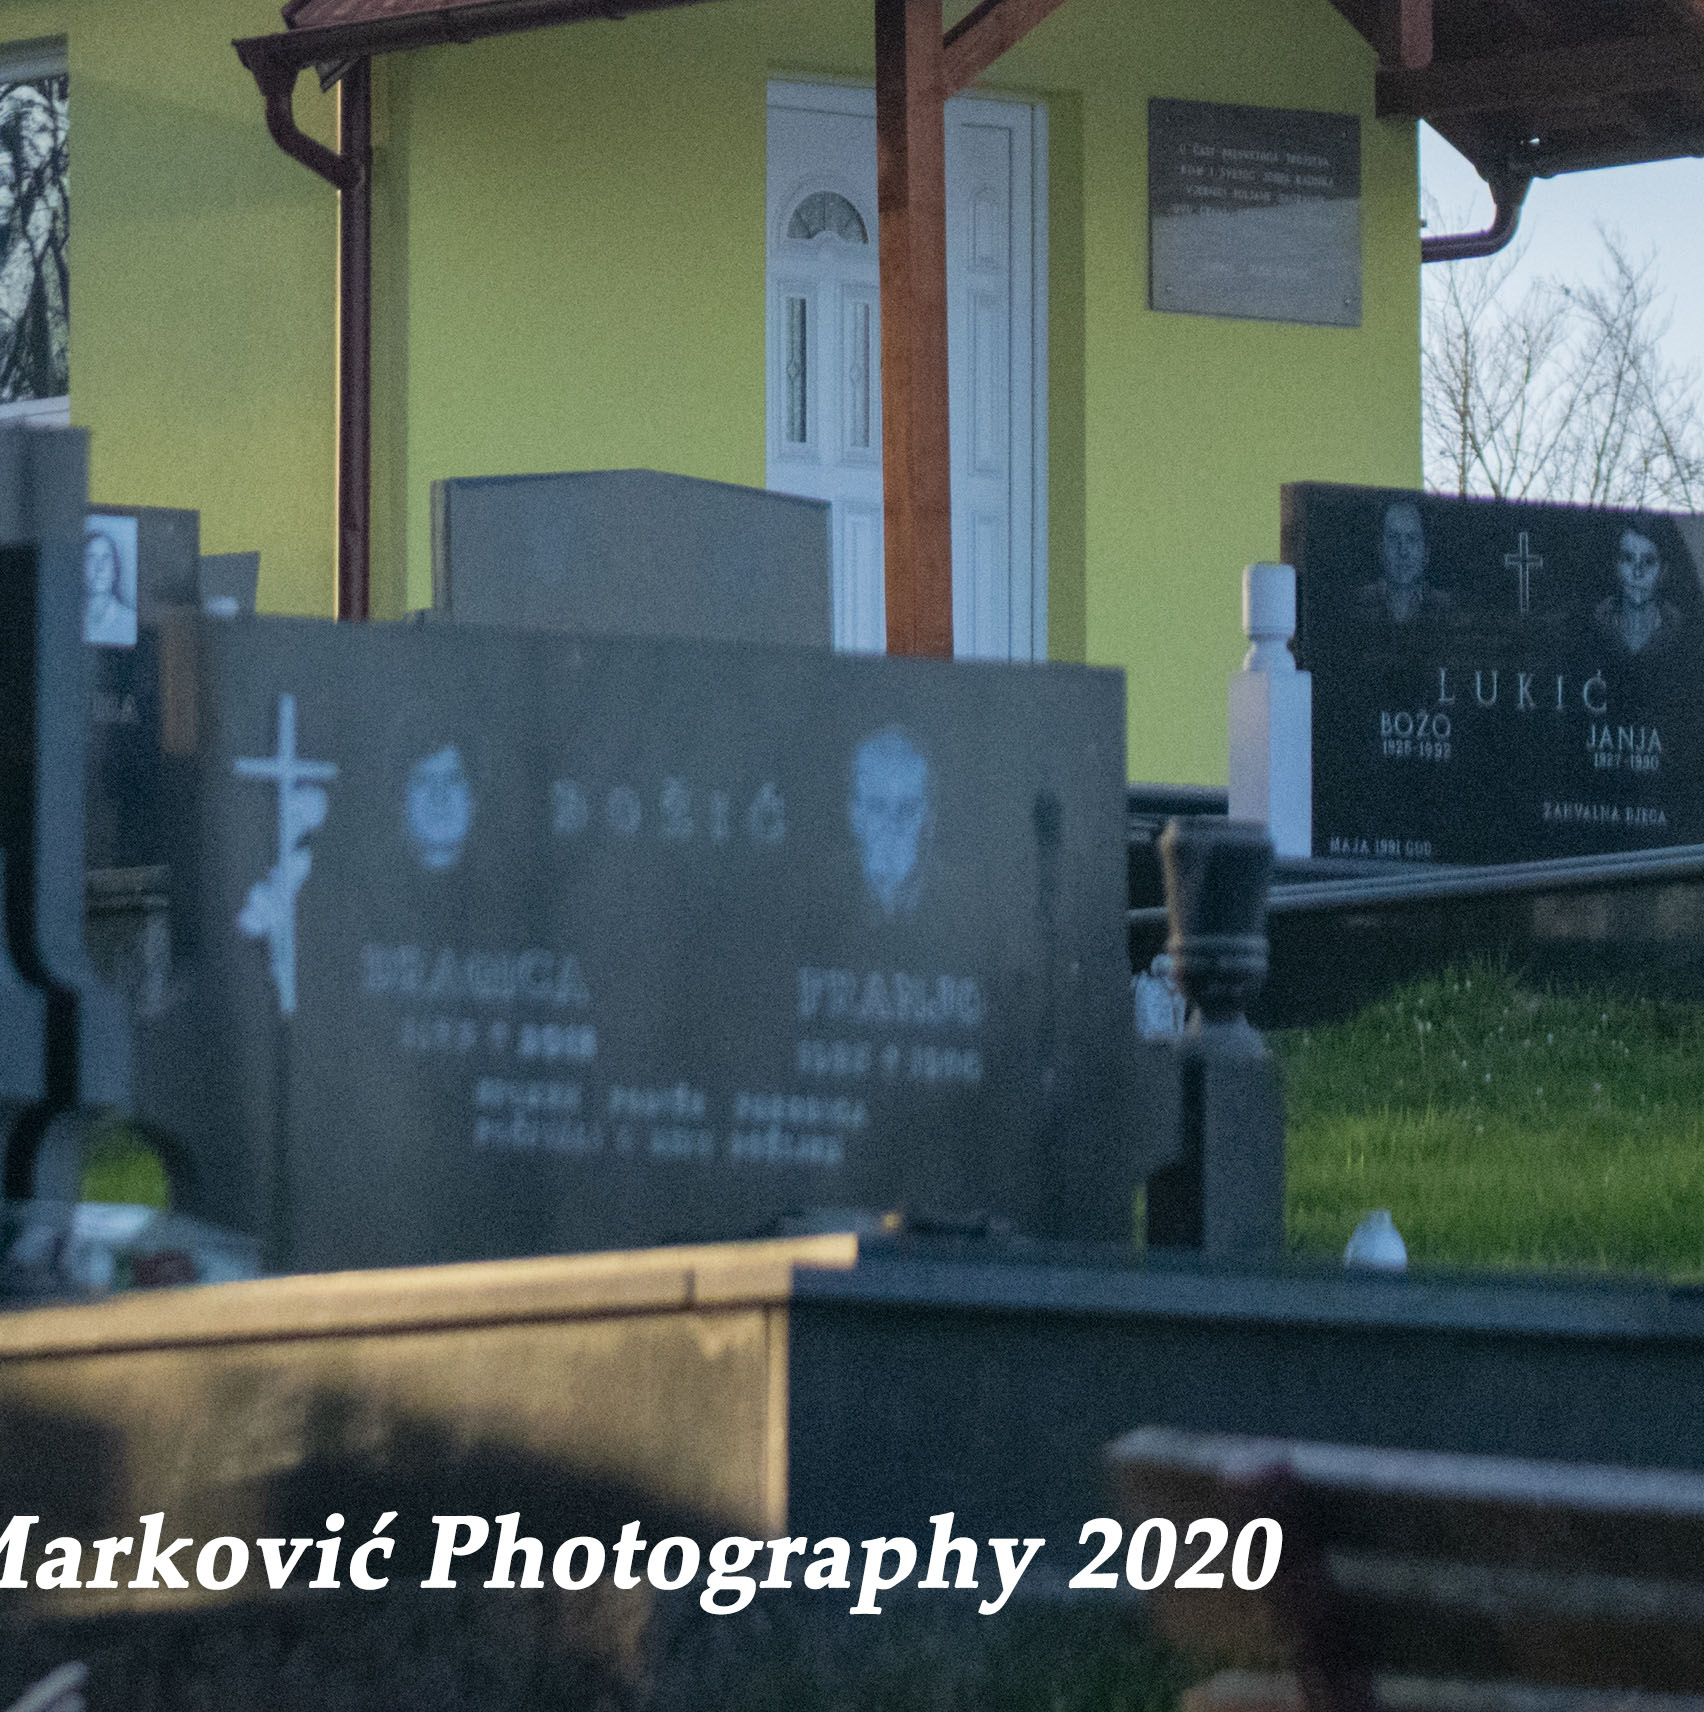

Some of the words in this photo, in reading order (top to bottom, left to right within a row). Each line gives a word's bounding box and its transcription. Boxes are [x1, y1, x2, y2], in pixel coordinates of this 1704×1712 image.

[1438, 667, 1609, 716] LUKIĆ
[1380, 708, 1453, 740] BOŽO
[1586, 723, 1664, 755] JANJA
[1542, 800, 1620, 824] ZAHVALNA
[1624, 806, 1668, 829] DJECA
